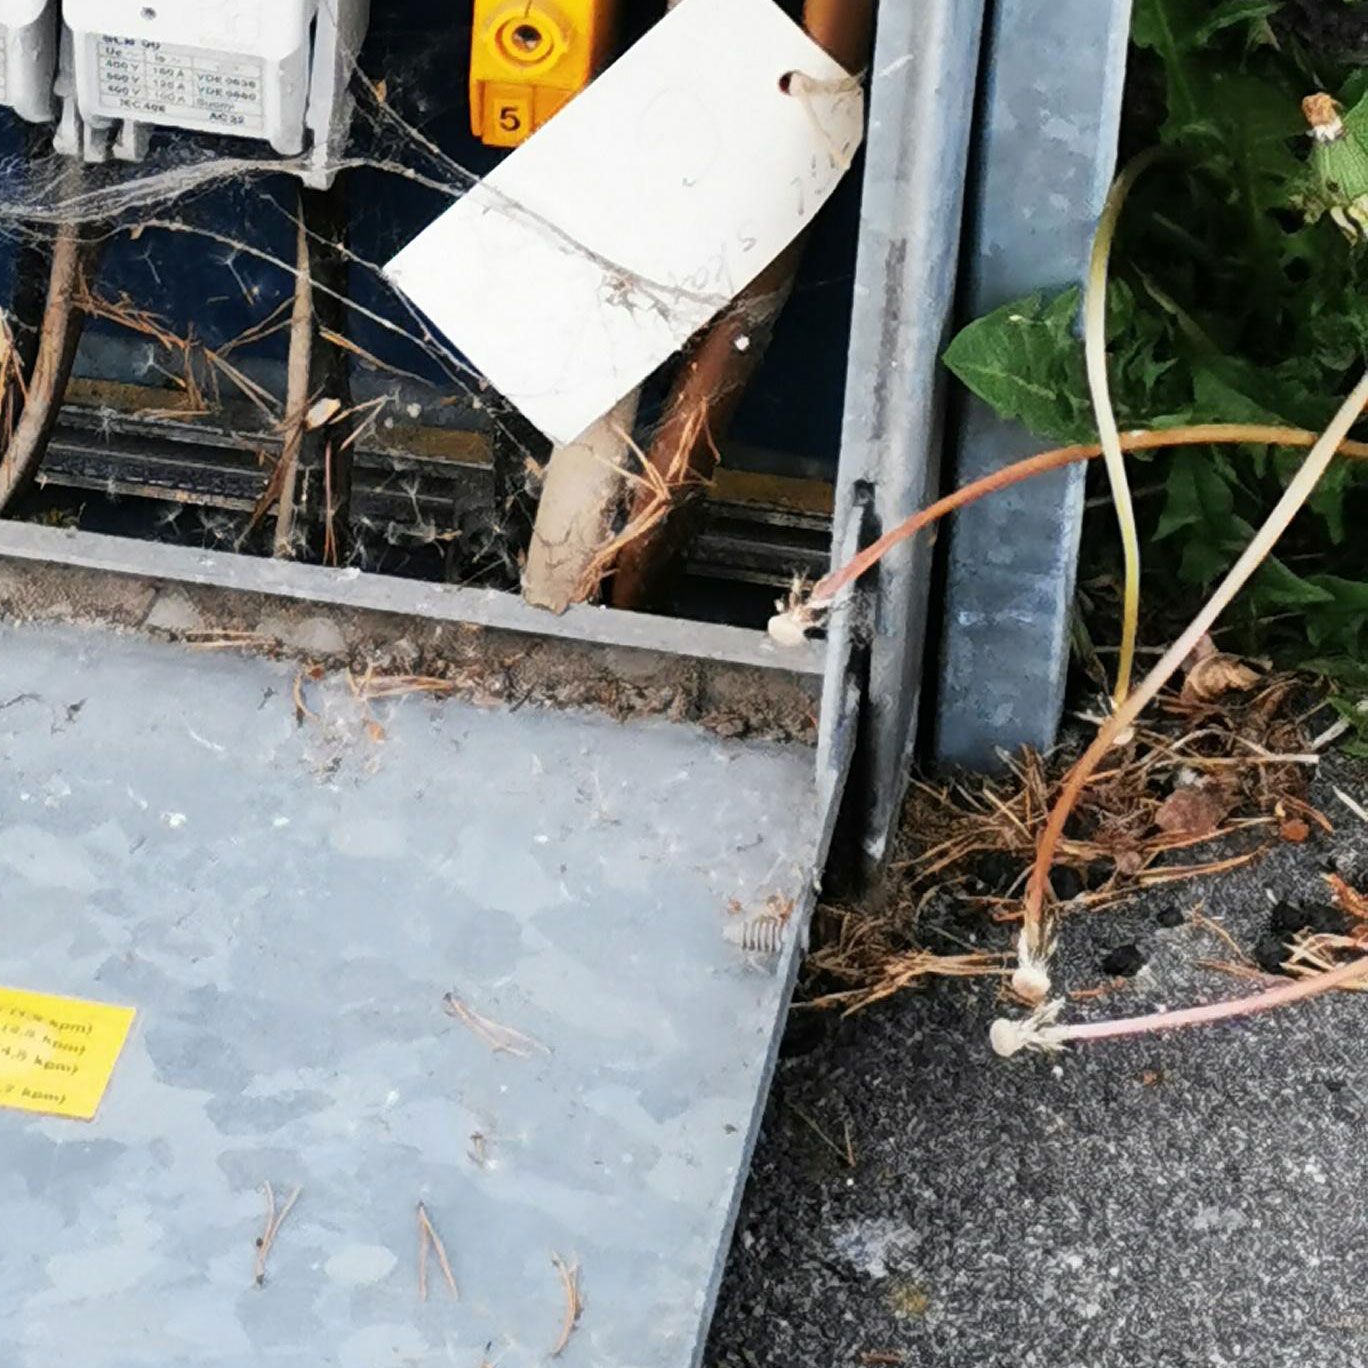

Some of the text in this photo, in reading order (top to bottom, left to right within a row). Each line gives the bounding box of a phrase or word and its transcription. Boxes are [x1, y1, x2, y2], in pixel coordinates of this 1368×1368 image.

[210, 112, 228, 123] AC
[499, 106, 521, 131] 5
[43, 1035, 86, 1055] kpm)
[34, 1055, 79, 1076] kpm)
[22, 1088, 67, 1105] kpm)
